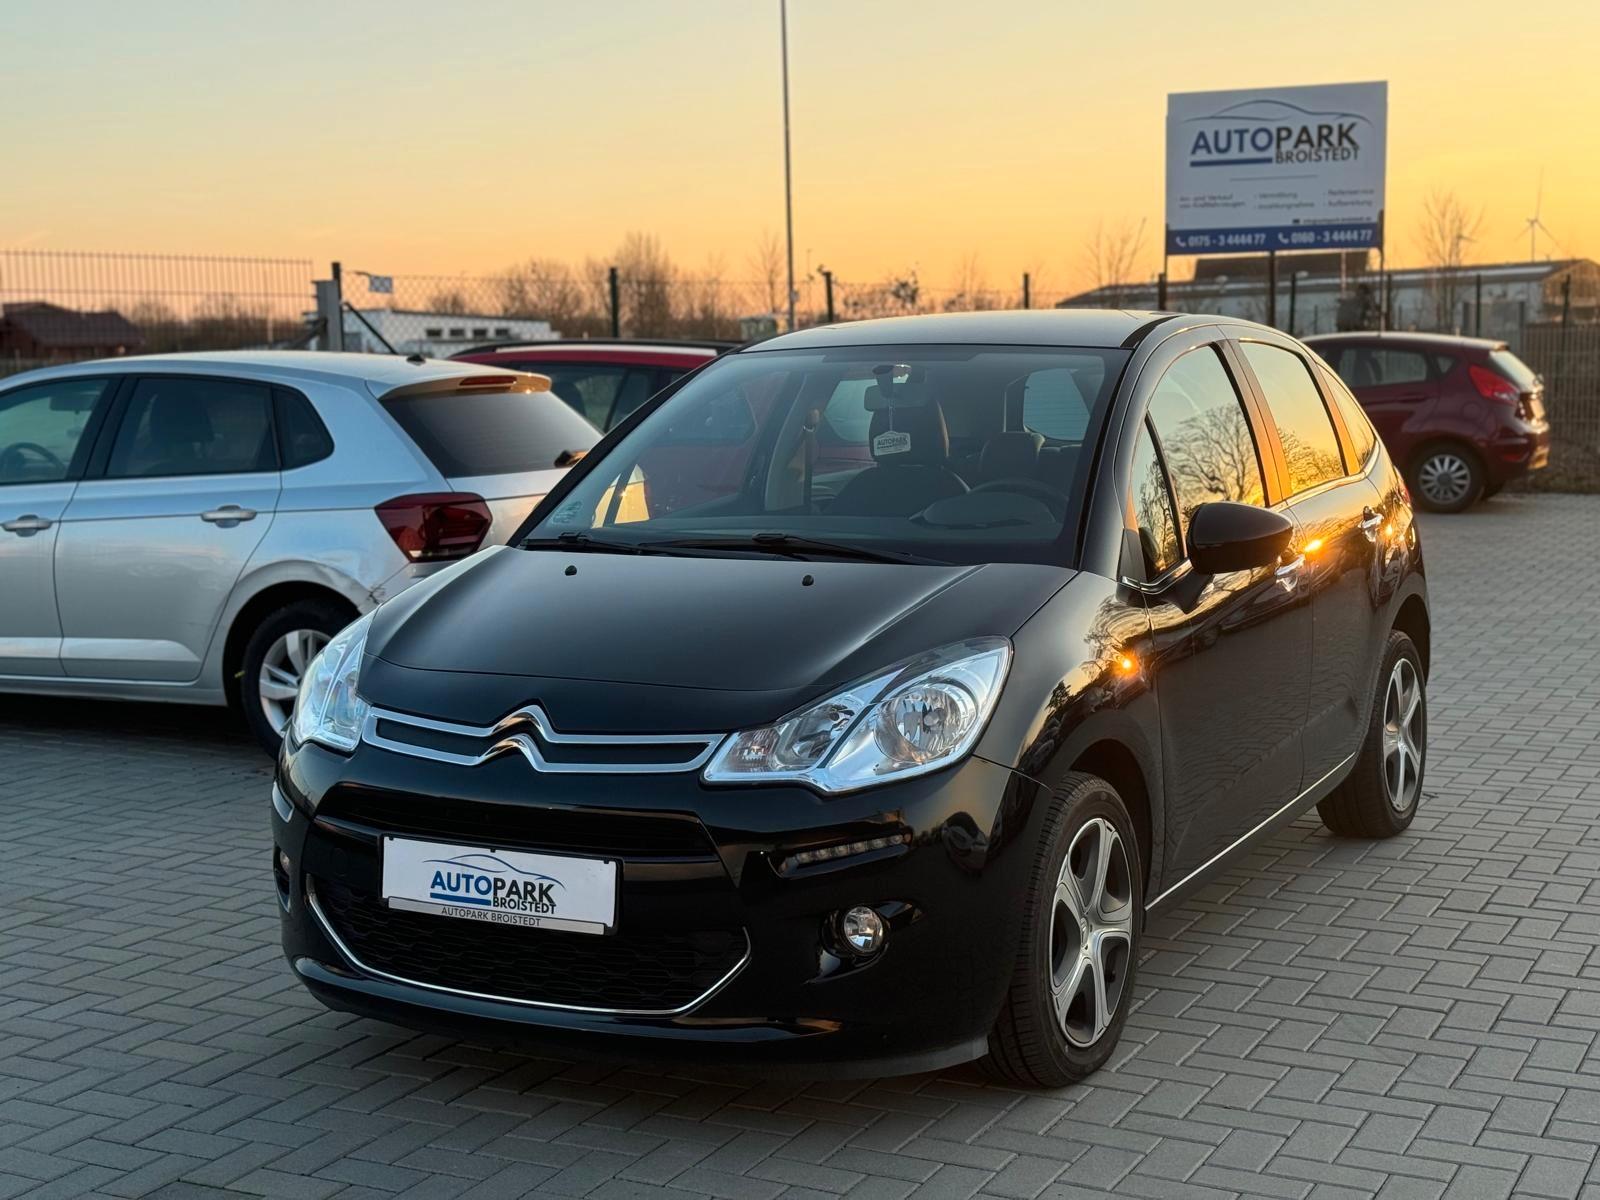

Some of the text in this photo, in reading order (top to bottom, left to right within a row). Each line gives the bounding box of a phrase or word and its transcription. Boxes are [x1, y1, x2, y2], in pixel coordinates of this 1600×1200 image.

[1190, 122, 1359, 155] AUTOPARK
[1275, 147, 1360, 164] BROISTEDT
[430, 870, 557, 904] AUTOPARK
[492, 896, 557, 914] BROISTEDT
[441, 906, 541, 927] AUTOPARK BROISTEDT
